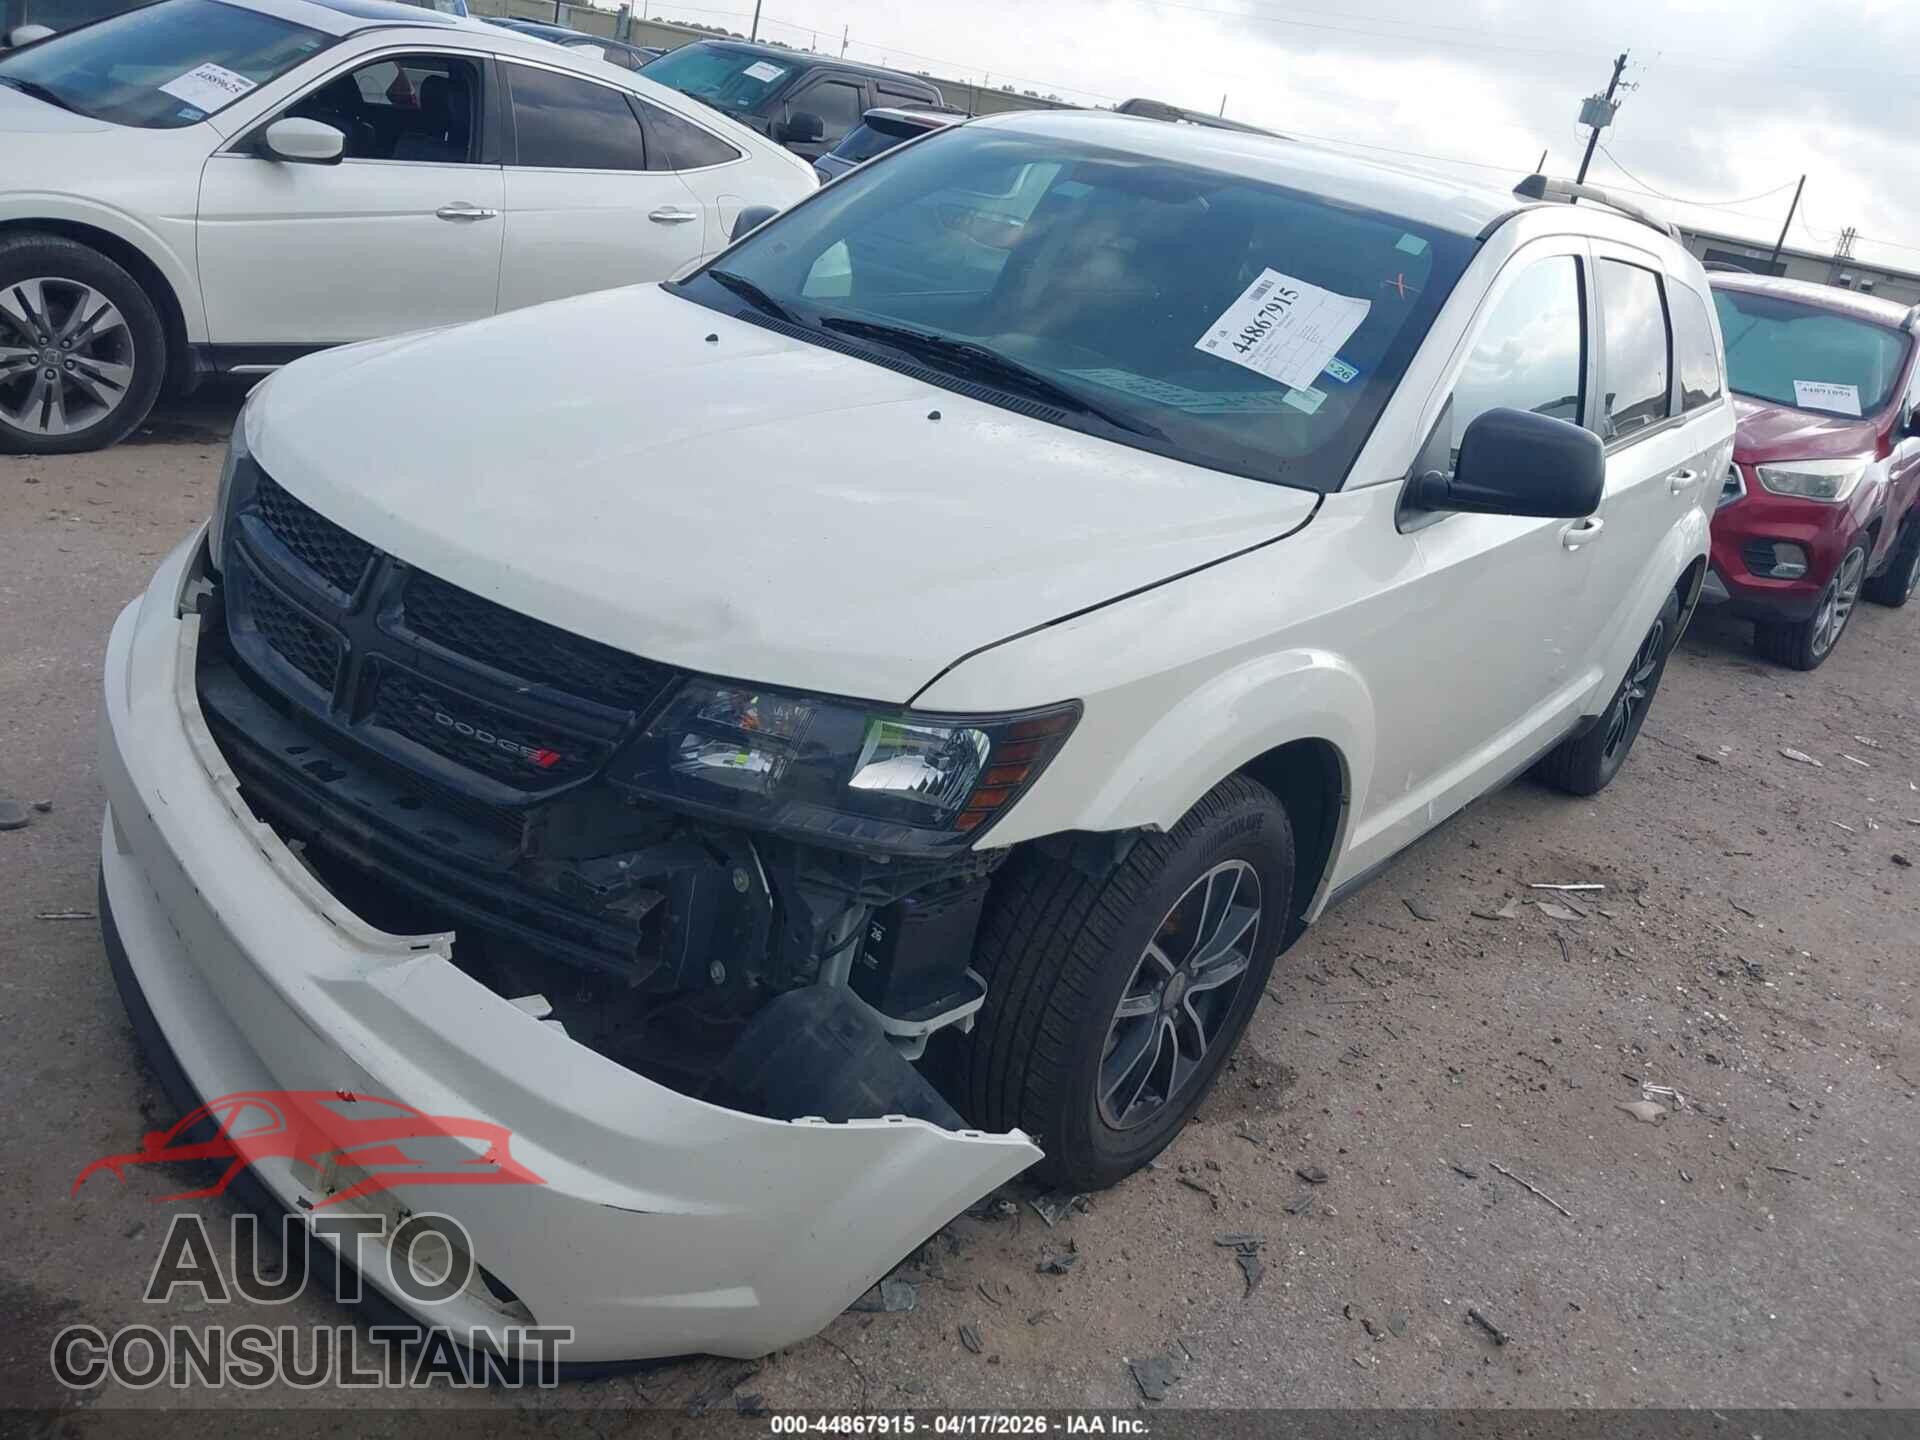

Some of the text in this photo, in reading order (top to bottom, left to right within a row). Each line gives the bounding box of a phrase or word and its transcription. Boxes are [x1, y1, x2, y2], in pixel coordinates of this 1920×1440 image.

[1232, 287, 1300, 354] 44867915
[1333, 366, 1351, 380] 26
[434, 711, 542, 761] DODGE
